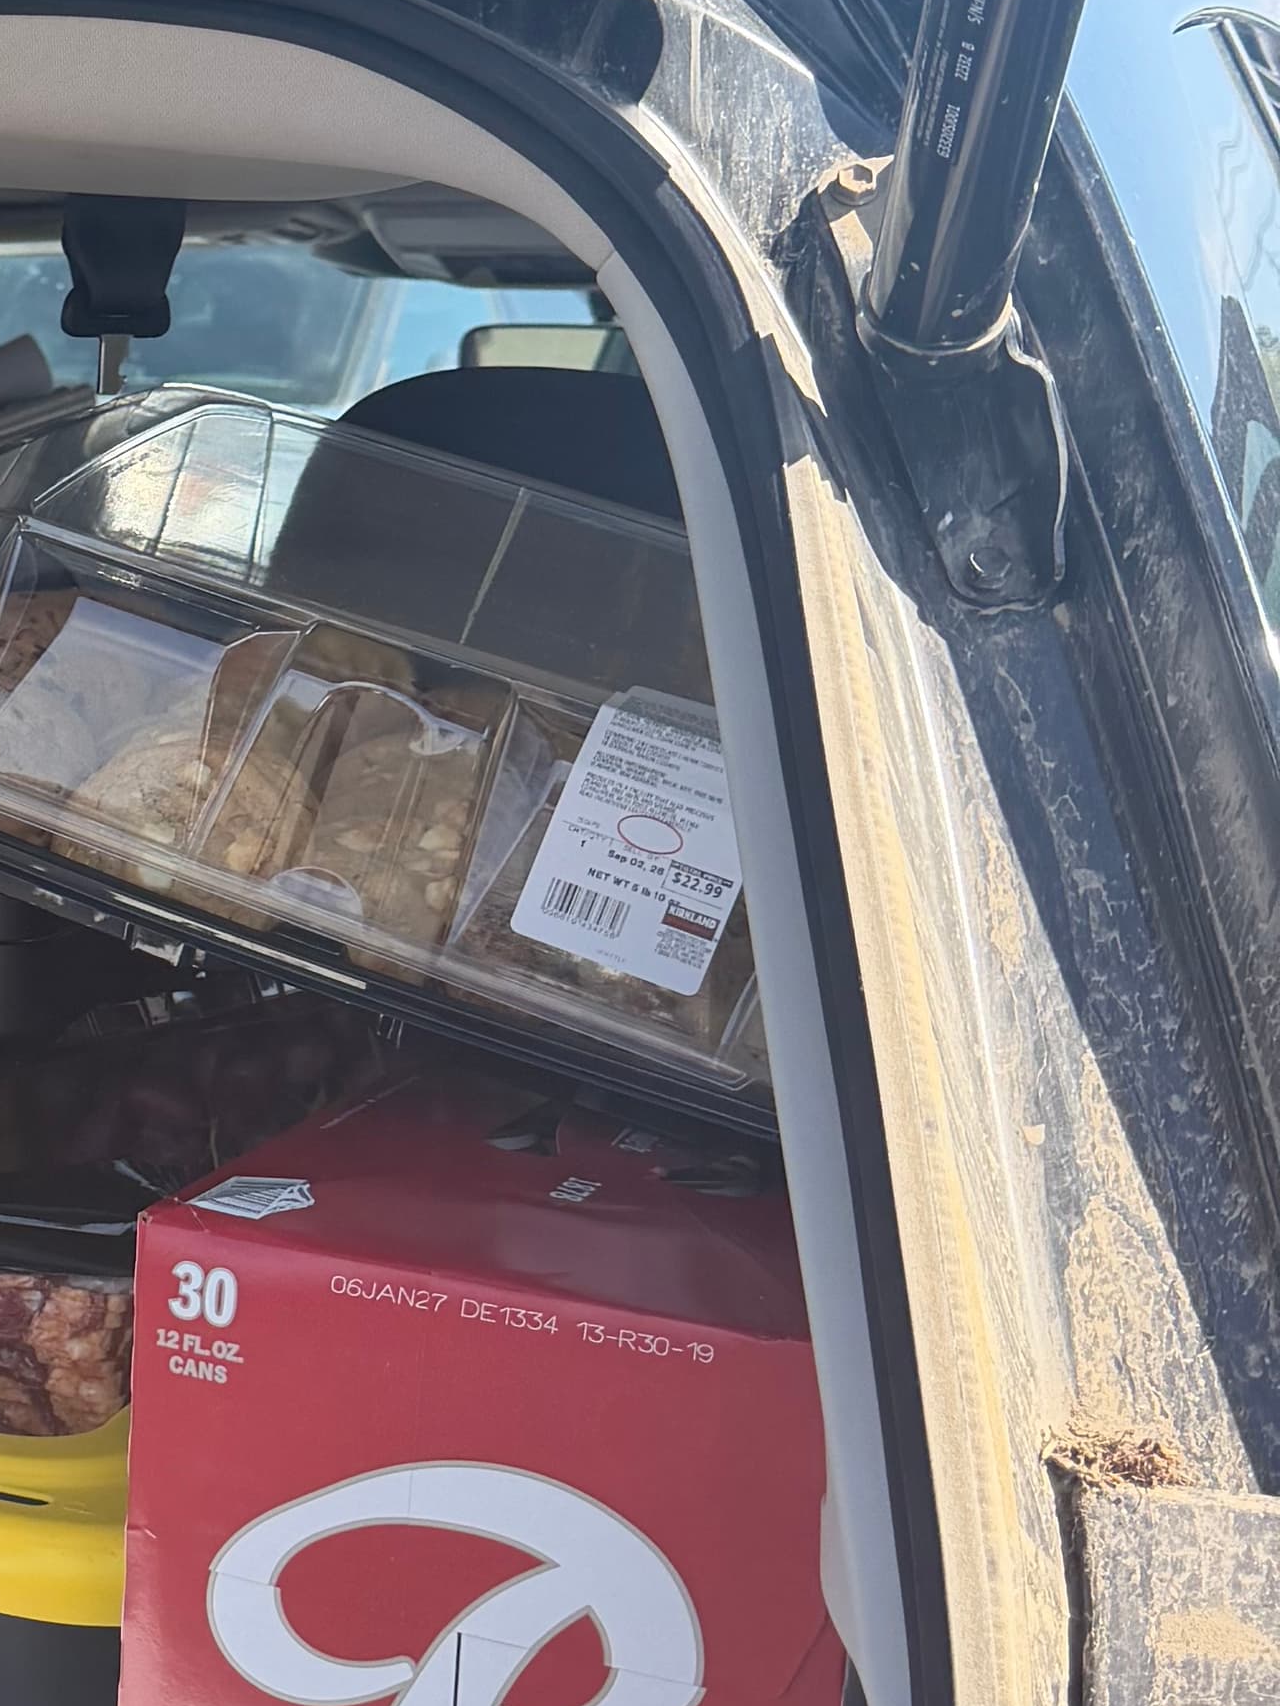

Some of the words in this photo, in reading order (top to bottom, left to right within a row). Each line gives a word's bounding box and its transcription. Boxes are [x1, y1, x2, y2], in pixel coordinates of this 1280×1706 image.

[588, 868, 609, 881] NET
[612, 876, 629, 888] WT
[671, 872, 723, 899] $22.99
[668, 905, 717, 929] KIRKLAND
[168, 1261, 238, 1328] 30
[331, 1275, 448, 1313] 06JAN27
[461, 1299, 559, 1335] DE1334
[578, 1321, 715, 1364] 13-R30-19
[156, 1329, 180, 1349] 12
[169, 1356, 228, 1384] CANS
